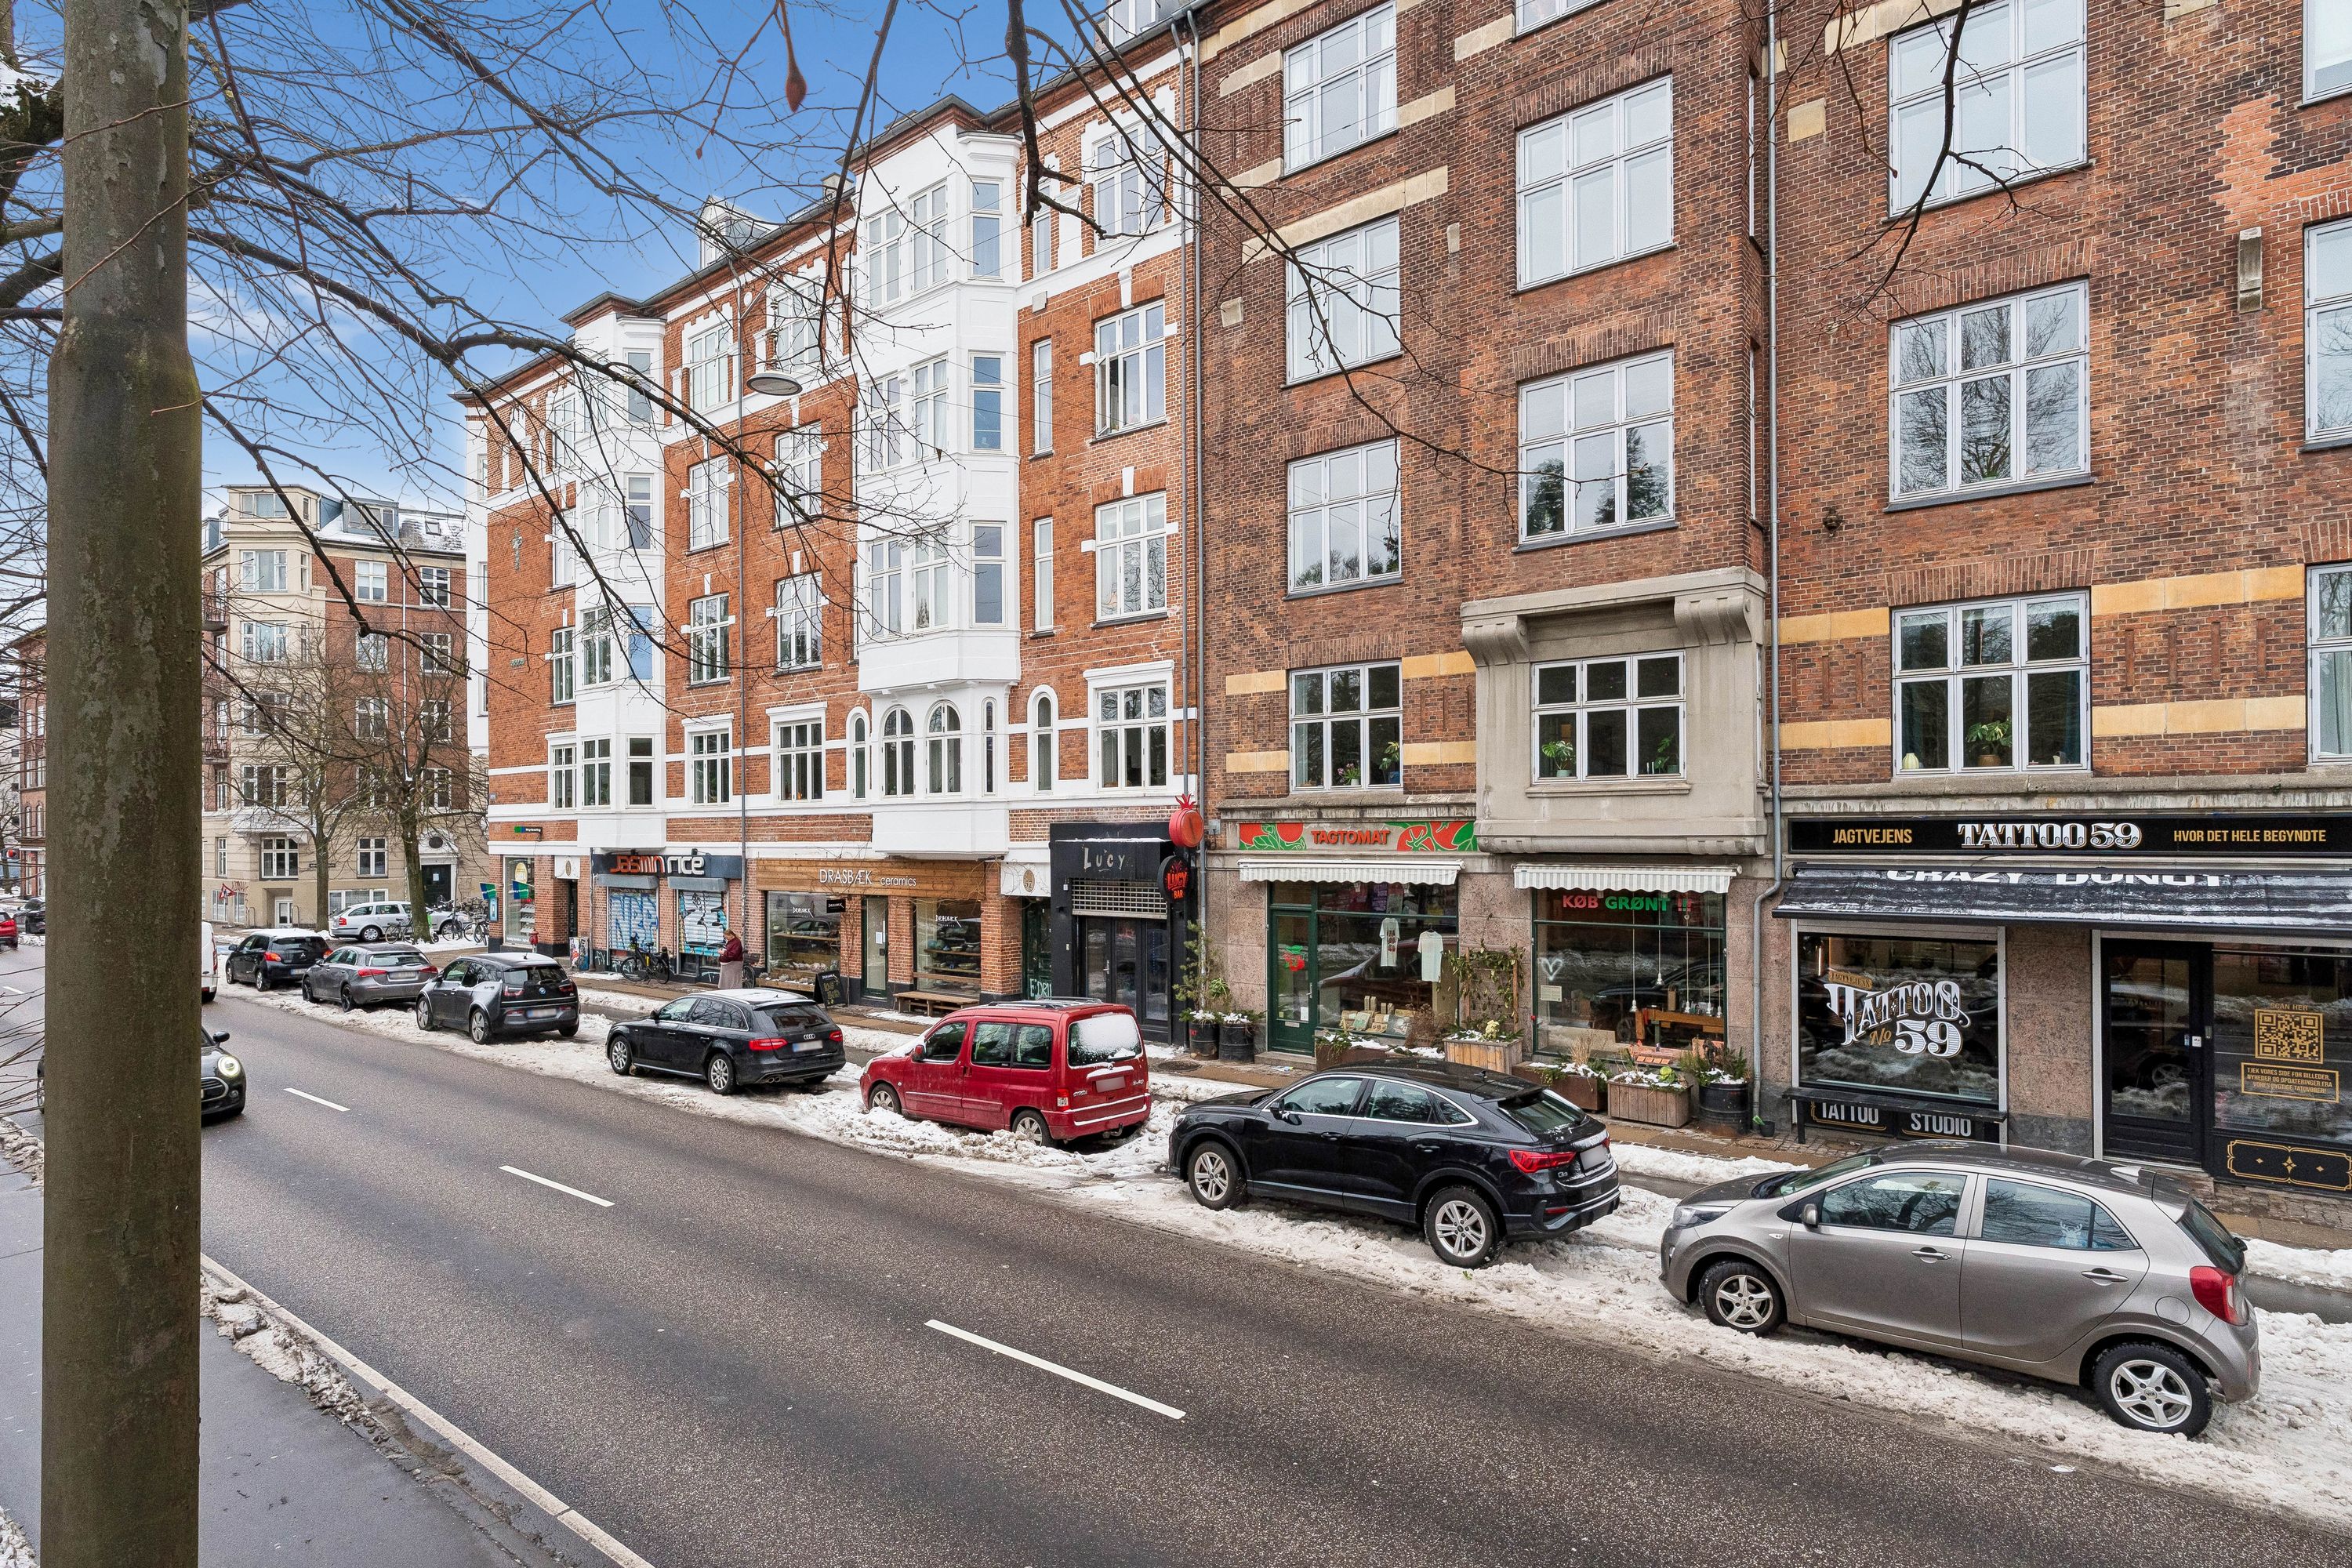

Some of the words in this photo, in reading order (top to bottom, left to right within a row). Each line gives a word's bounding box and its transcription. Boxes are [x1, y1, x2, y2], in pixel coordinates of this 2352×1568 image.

[1311, 829, 1391, 845] TAGTOMAT
[1833, 829, 1912, 844] JAGTVEJENS
[1958, 822, 2087, 848] TATTOO
[2090, 822, 2142, 849] 59
[2174, 829, 2204, 842] HVOR
[2207, 829, 2229, 842] DET
[2232, 829, 2261, 842] HELE
[2263, 829, 2327, 843] BEGYNDTE
[819, 869, 873, 884] DRASBÆK
[880, 876, 916, 887] ceramics
[1167, 871, 1187, 887] LUCY
[1174, 890, 1183, 899] BAR
[1563, 895, 1599, 909] KØB
[1605, 896, 1671, 912] GRØNT
[1824, 980, 1970, 1046] TATTOO
[1895, 1019, 1962, 1058] 59
[1911, 1112, 1972, 1137] STUDIO
